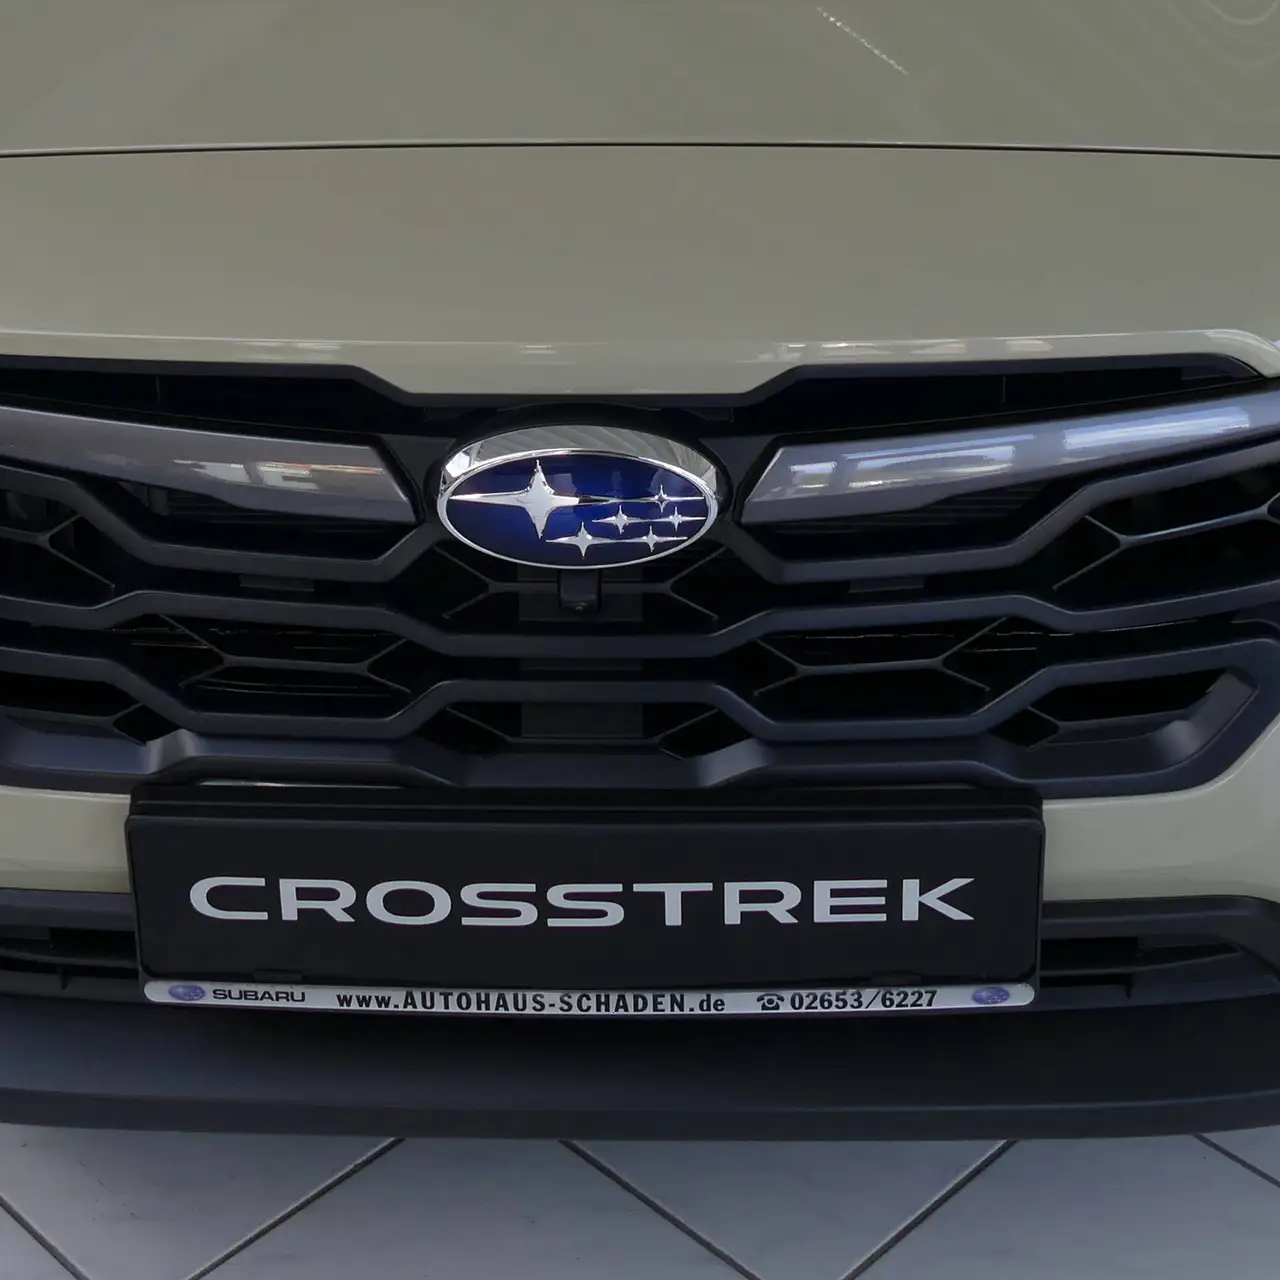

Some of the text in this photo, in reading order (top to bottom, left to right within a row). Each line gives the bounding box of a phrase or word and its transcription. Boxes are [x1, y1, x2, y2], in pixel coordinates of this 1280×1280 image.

[190, 876, 975, 928] CROSSTREK
[211, 988, 939, 1013] SUBARU www.AUTOHAUS-SCHADEN.de 02653/6227
